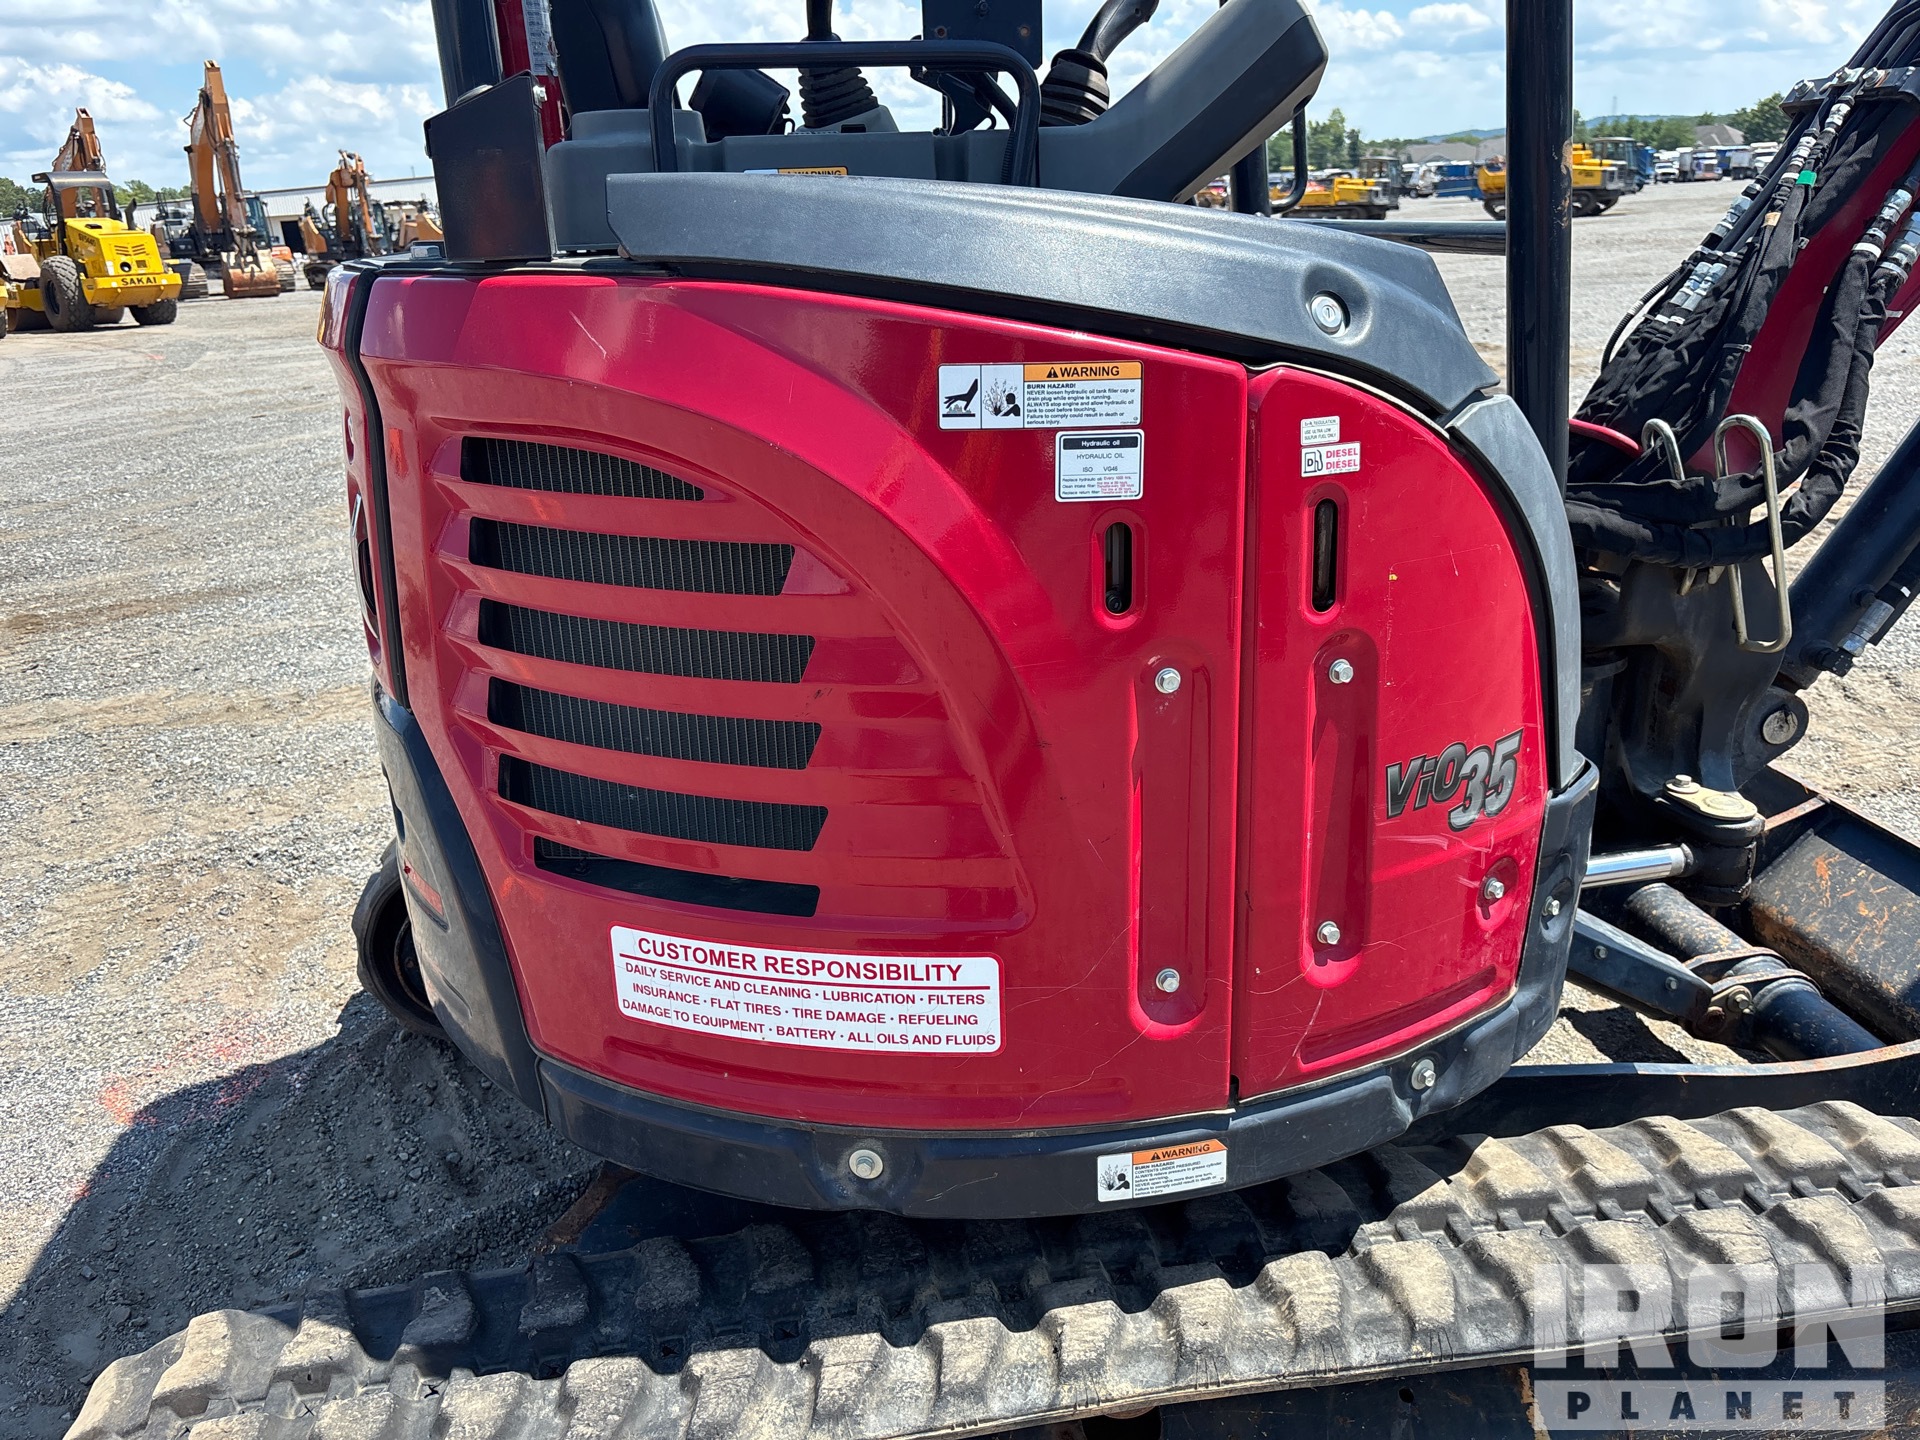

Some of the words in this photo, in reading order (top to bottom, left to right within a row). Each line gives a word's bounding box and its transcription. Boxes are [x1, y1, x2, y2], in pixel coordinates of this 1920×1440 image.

[121, 277, 157, 286] SAKAI
[1060, 366, 1120, 377] WARNING
[1326, 448, 1358, 458] DIESEL
[638, 938, 758, 971] CUSTOMER
[764, 956, 962, 982] RESPONSIBILITY
[626, 962, 656, 978] DAILY
[660, 969, 711, 988] SERVICE
[714, 978, 741, 992] AND
[744, 983, 811, 999] CLEANING
[823, 990, 915, 1004] LUBRICATION
[928, 994, 985, 1005] FILTERS
[633, 982, 700, 1005] INSURANCE
[711, 998, 741, 1011] FLAT
[744, 1002, 782, 1016] TIRES
[792, 1008, 822, 1020] TIRE
[826, 1011, 886, 1023] DAMAGE
[898, 1014, 978, 1025] REFUELING
[622, 999, 671, 1018] DAMAGE
[673, 1010, 689, 1022] TO
[693, 1014, 765, 1034] EQUIPMENT
[776, 1026, 836, 1040] BATTERY
[848, 1032, 873, 1043] ALL
[877, 1033, 908, 1044] OILS
[912, 1035, 942, 1045] AND
[946, 1034, 996, 1045] FLUIDS
[1162, 1144, 1210, 1159] WARNING
